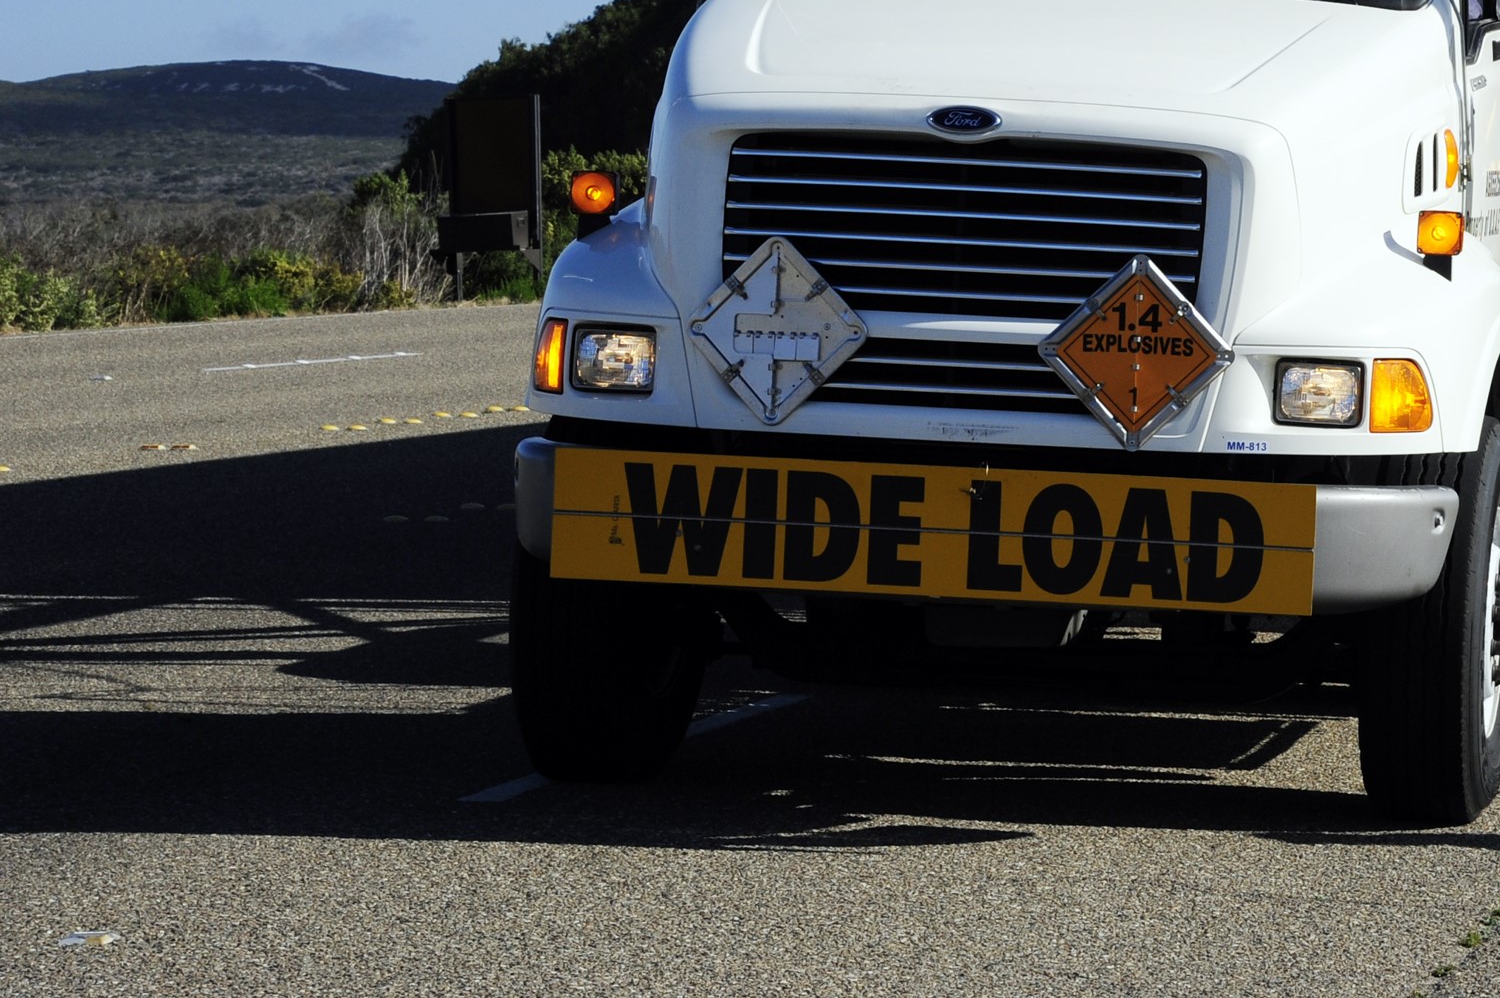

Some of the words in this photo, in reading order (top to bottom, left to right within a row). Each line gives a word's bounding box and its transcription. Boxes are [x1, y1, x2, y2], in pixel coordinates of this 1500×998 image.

[944, 111, 981, 127] Ford
[1112, 302, 1162, 333] 1.4
[1082, 333, 1194, 357] EXPLOSIVES
[1128, 387, 1138, 406] 1
[1227, 441, 1267, 451] MM-813
[624, 462, 925, 588] WIDE
[966, 479, 1265, 603] LOAD
